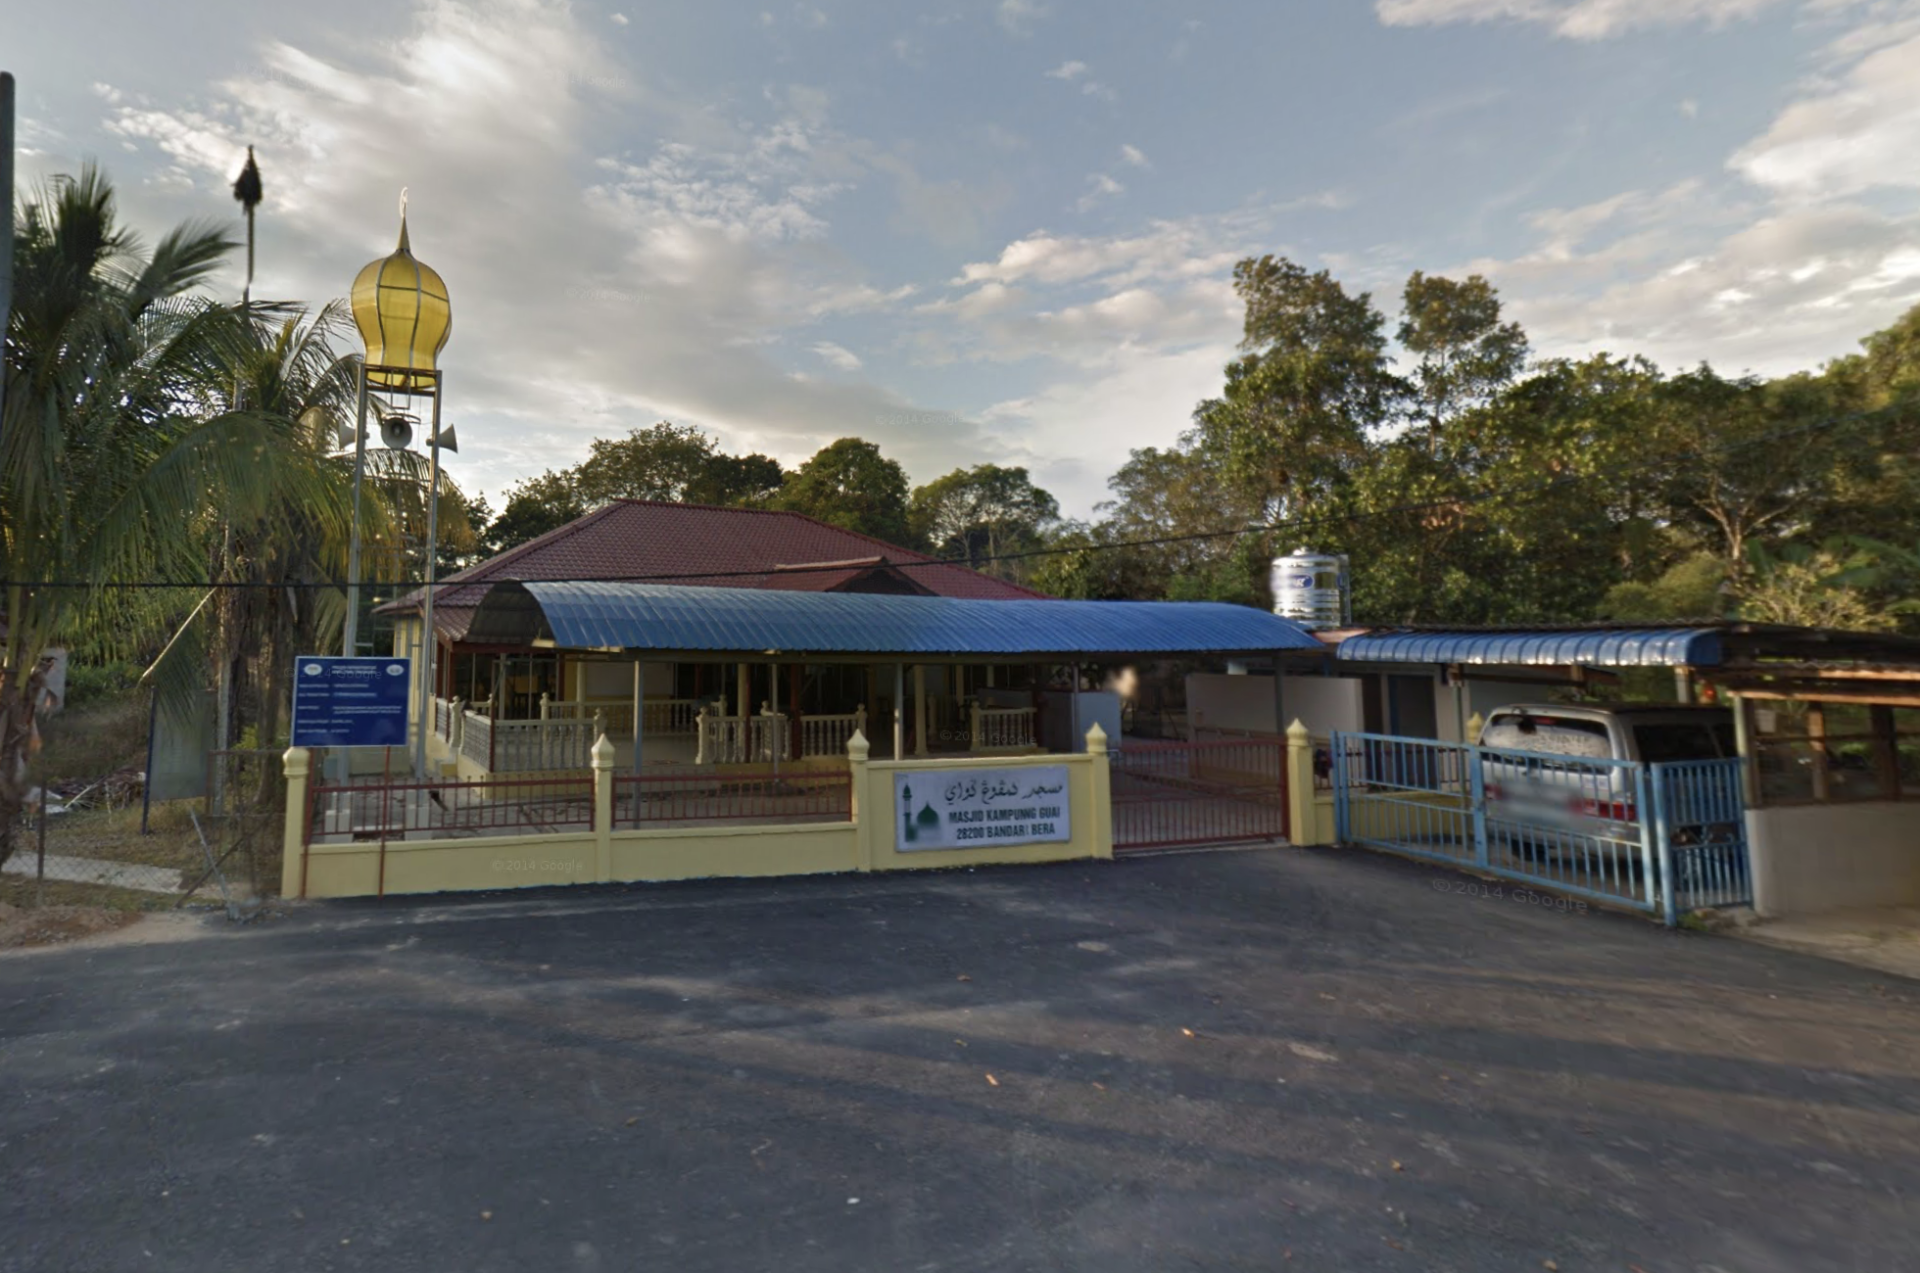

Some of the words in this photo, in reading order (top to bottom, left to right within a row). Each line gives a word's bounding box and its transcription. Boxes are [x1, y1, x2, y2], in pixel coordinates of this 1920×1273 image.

[948, 810, 984, 824] MASJID
[1039, 806, 1061, 819] GUAI
[987, 825, 1025, 838] BANDAR
[1031, 823, 1056, 835] BERA
